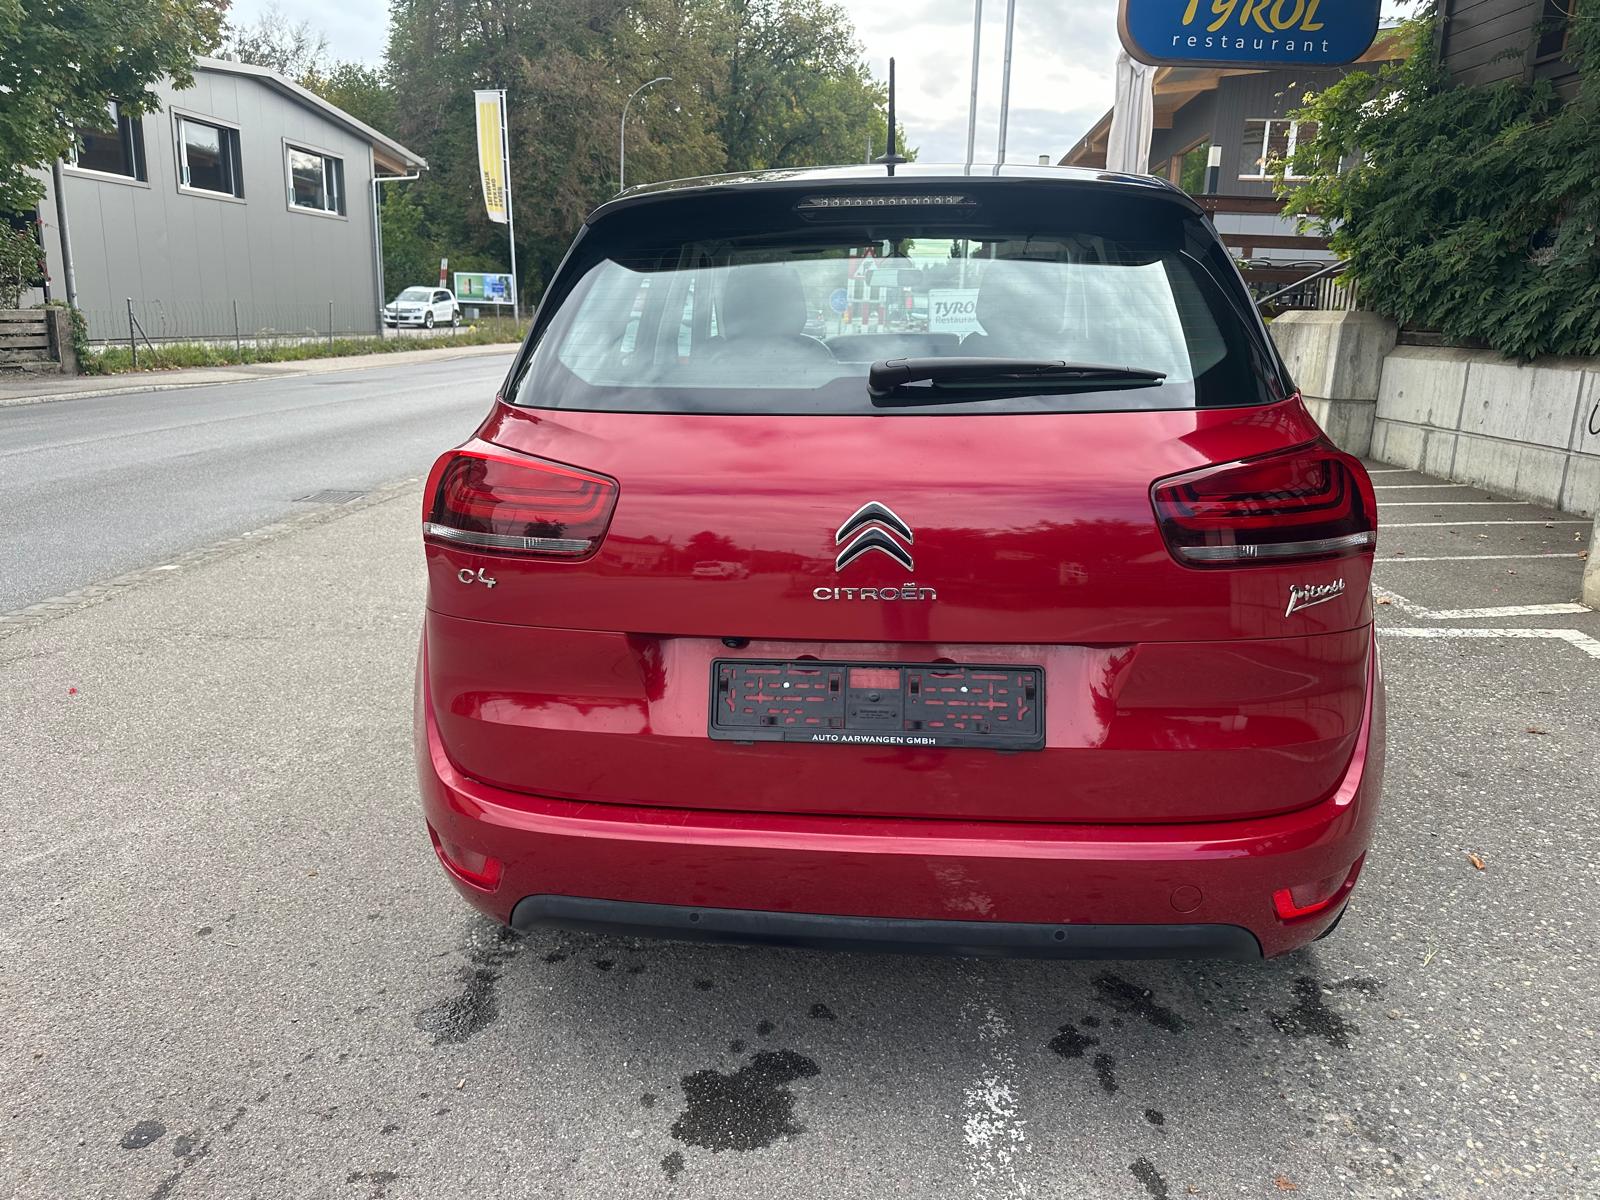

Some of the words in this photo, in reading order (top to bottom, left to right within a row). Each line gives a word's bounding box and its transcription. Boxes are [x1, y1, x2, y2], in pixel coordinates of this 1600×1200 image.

[1172, 35, 1329, 52] restaurant
[934, 301, 975, 317] TYRO
[457, 567, 497, 588] C4
[840, 735, 904, 743] AARWANGEN
[906, 737, 936, 745] GMBH
